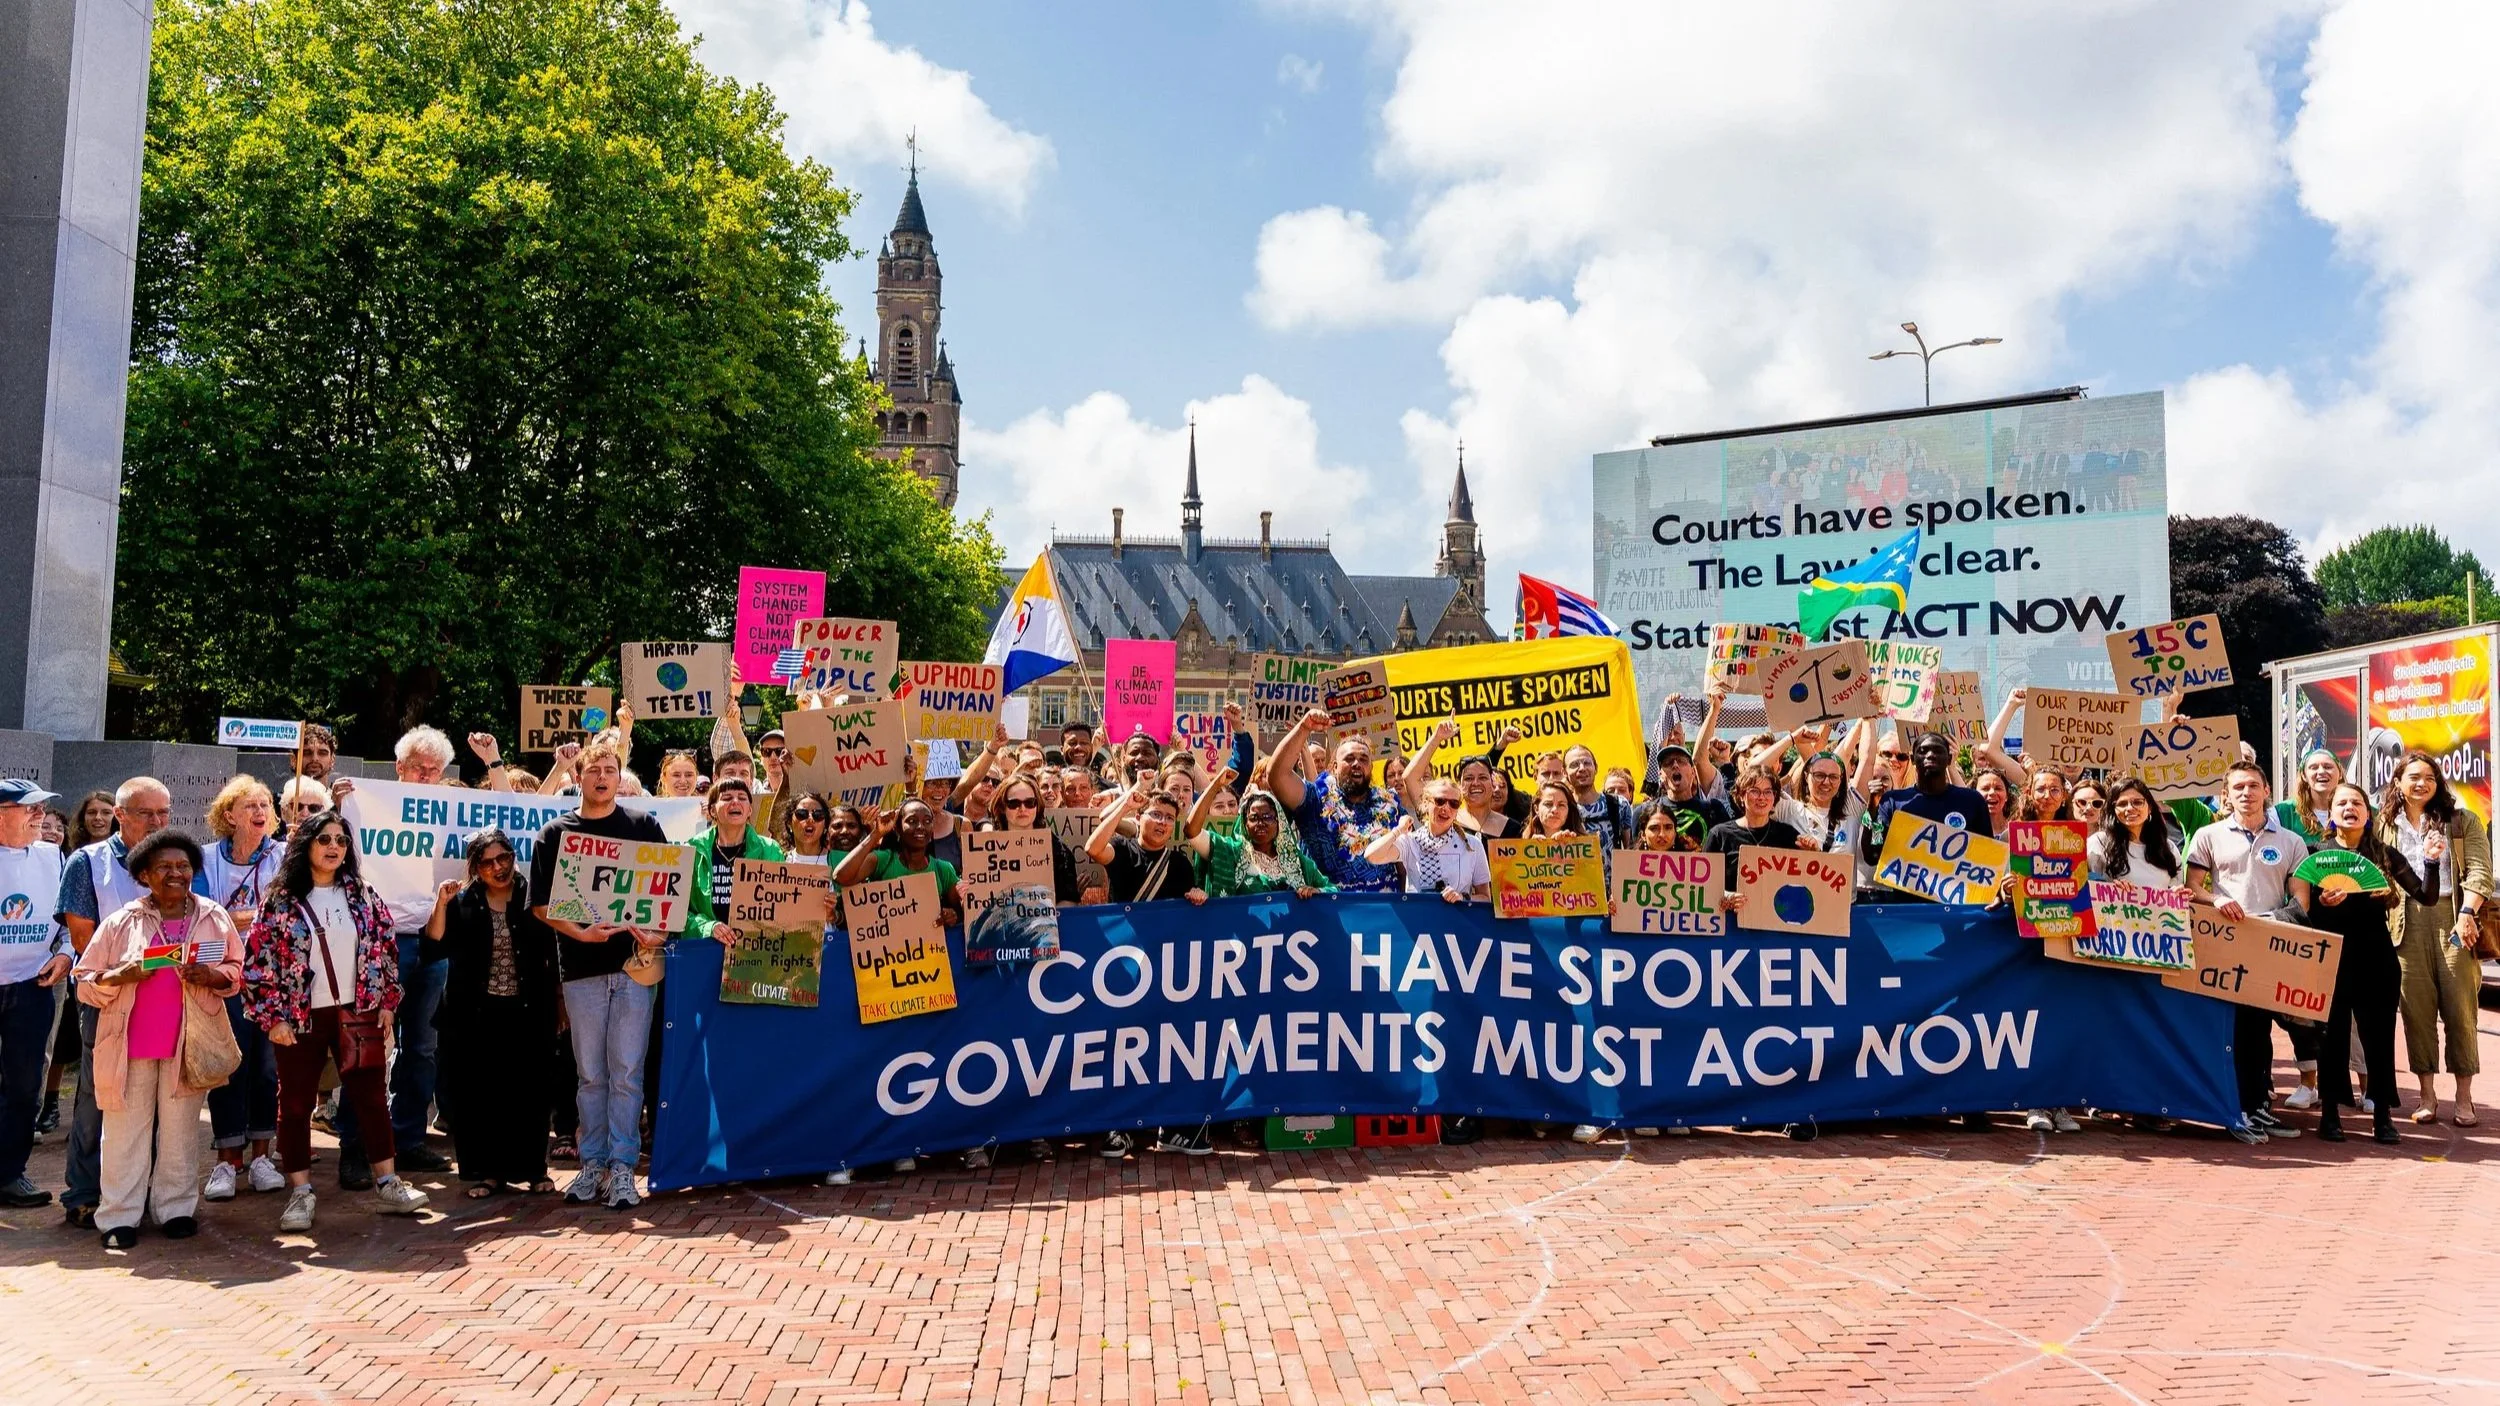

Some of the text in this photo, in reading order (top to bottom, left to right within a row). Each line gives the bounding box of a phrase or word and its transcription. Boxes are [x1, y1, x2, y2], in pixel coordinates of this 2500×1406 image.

[1652, 487, 2085, 545] Courts have spoken.
[1920, 543, 2040, 575] clear.
[1688, 558, 1762, 590] The
[754, 581, 808, 597] SYSTEM
[752, 597, 808, 612] CHANGE
[766, 613, 792, 626] NOT
[1631, 594, 2126, 650] Stat ACT NOW.
[801, 622, 882, 643] POWER
[643, 643, 698, 658] HARIAP
[840, 648, 873, 663] THE
[1132, 666, 1147, 677] DE
[2144, 655, 2185, 674] TO
[914, 663, 995, 691] UPHOLD
[1115, 680, 1163, 692] KLIMAAT
[1765, 655, 1798, 699] CLIMATE
[2130, 674, 2176, 696] STAY
[532, 689, 587, 705] THERE
[1119, 693, 1157, 705] IS VOL!
[1254, 683, 1319, 703] JUSTICE
[1391, 667, 1607, 717] OURTS HAVE SPOKEN
[1832, 672, 1868, 705] JUSTICE!
[2374, 690, 2384, 703] en
[919, 689, 994, 713] HUMAN
[1255, 702, 1291, 720] YUMI
[1930, 697, 1964, 714] rotect
[2036, 694, 2129, 714] OUR PLANET
[2388, 698, 2485, 721] voor binnen en buiten!
[544, 709, 562, 728] IS
[827, 709, 876, 731] YUMI
[1176, 713, 1232, 734] CLIMAT
[2047, 716, 2114, 736] DEPENDS
[836, 731, 871, 751] NA
[1181, 734, 1232, 752] JUSTI
[2061, 735, 2094, 745] ON THE
[2138, 725, 2198, 760] AO
[834, 749, 888, 774] YUMI
[2195, 752, 2235, 777] GO!
[401, 798, 571, 831] EEN LEEFBAR
[360, 828, 435, 858] VOOR
[564, 835, 682, 866] SAVE OUR
[968, 834, 1044, 852] Law of the
[1498, 844, 1594, 859] NO CLIMATE
[1911, 824, 1968, 861] AO
[988, 854, 1050, 872] Sea Court
[1516, 863, 1575, 879] JUSTICE
[1639, 854, 1711, 884] END
[1955, 861, 1995, 886] FOR
[592, 866, 681, 896] FUTUR
[740, 863, 830, 888] InterAmerican
[969, 870, 1000, 885] said
[1740, 855, 1847, 893] SAVE OUR
[1880, 858, 1965, 905] AFRICA
[754, 885, 802, 903] Court
[849, 880, 905, 907] World
[1528, 881, 1562, 890] WITHOUT
[878, 899, 918, 919] Court
[967, 888, 1046, 910] Protect the
[1501, 892, 1544, 910] HUMAN
[736, 903, 775, 921] said
[1642, 909, 1721, 933] FUELS
[2101, 904, 2152, 920] at the
[856, 919, 890, 942] said
[2040, 918, 2081, 933] TODAY
[1, 936, 16, 944] HET
[731, 928, 786, 952] Protect
[2132, 932, 2191, 964] COURT
[2269, 936, 2332, 963] must
[730, 954, 814, 972] Human Rights
[857, 937, 946, 977] Uphold the
[996, 947, 1030, 961] CLIMATE
[891, 968, 940, 988] Law
[1028, 930, 1319, 1014] COURTS
[1351, 932, 1532, 999] HAVE
[1559, 945, 1847, 1009] SPOKEN
[752, 982, 788, 1000] CLIMATE
[2200, 964, 2327, 1012] act now
[862, 994, 957, 1018] TAKE CLIMATE ACTION
[876, 1009, 2039, 1116] GOVERNMENTS MUST ACT NOW
